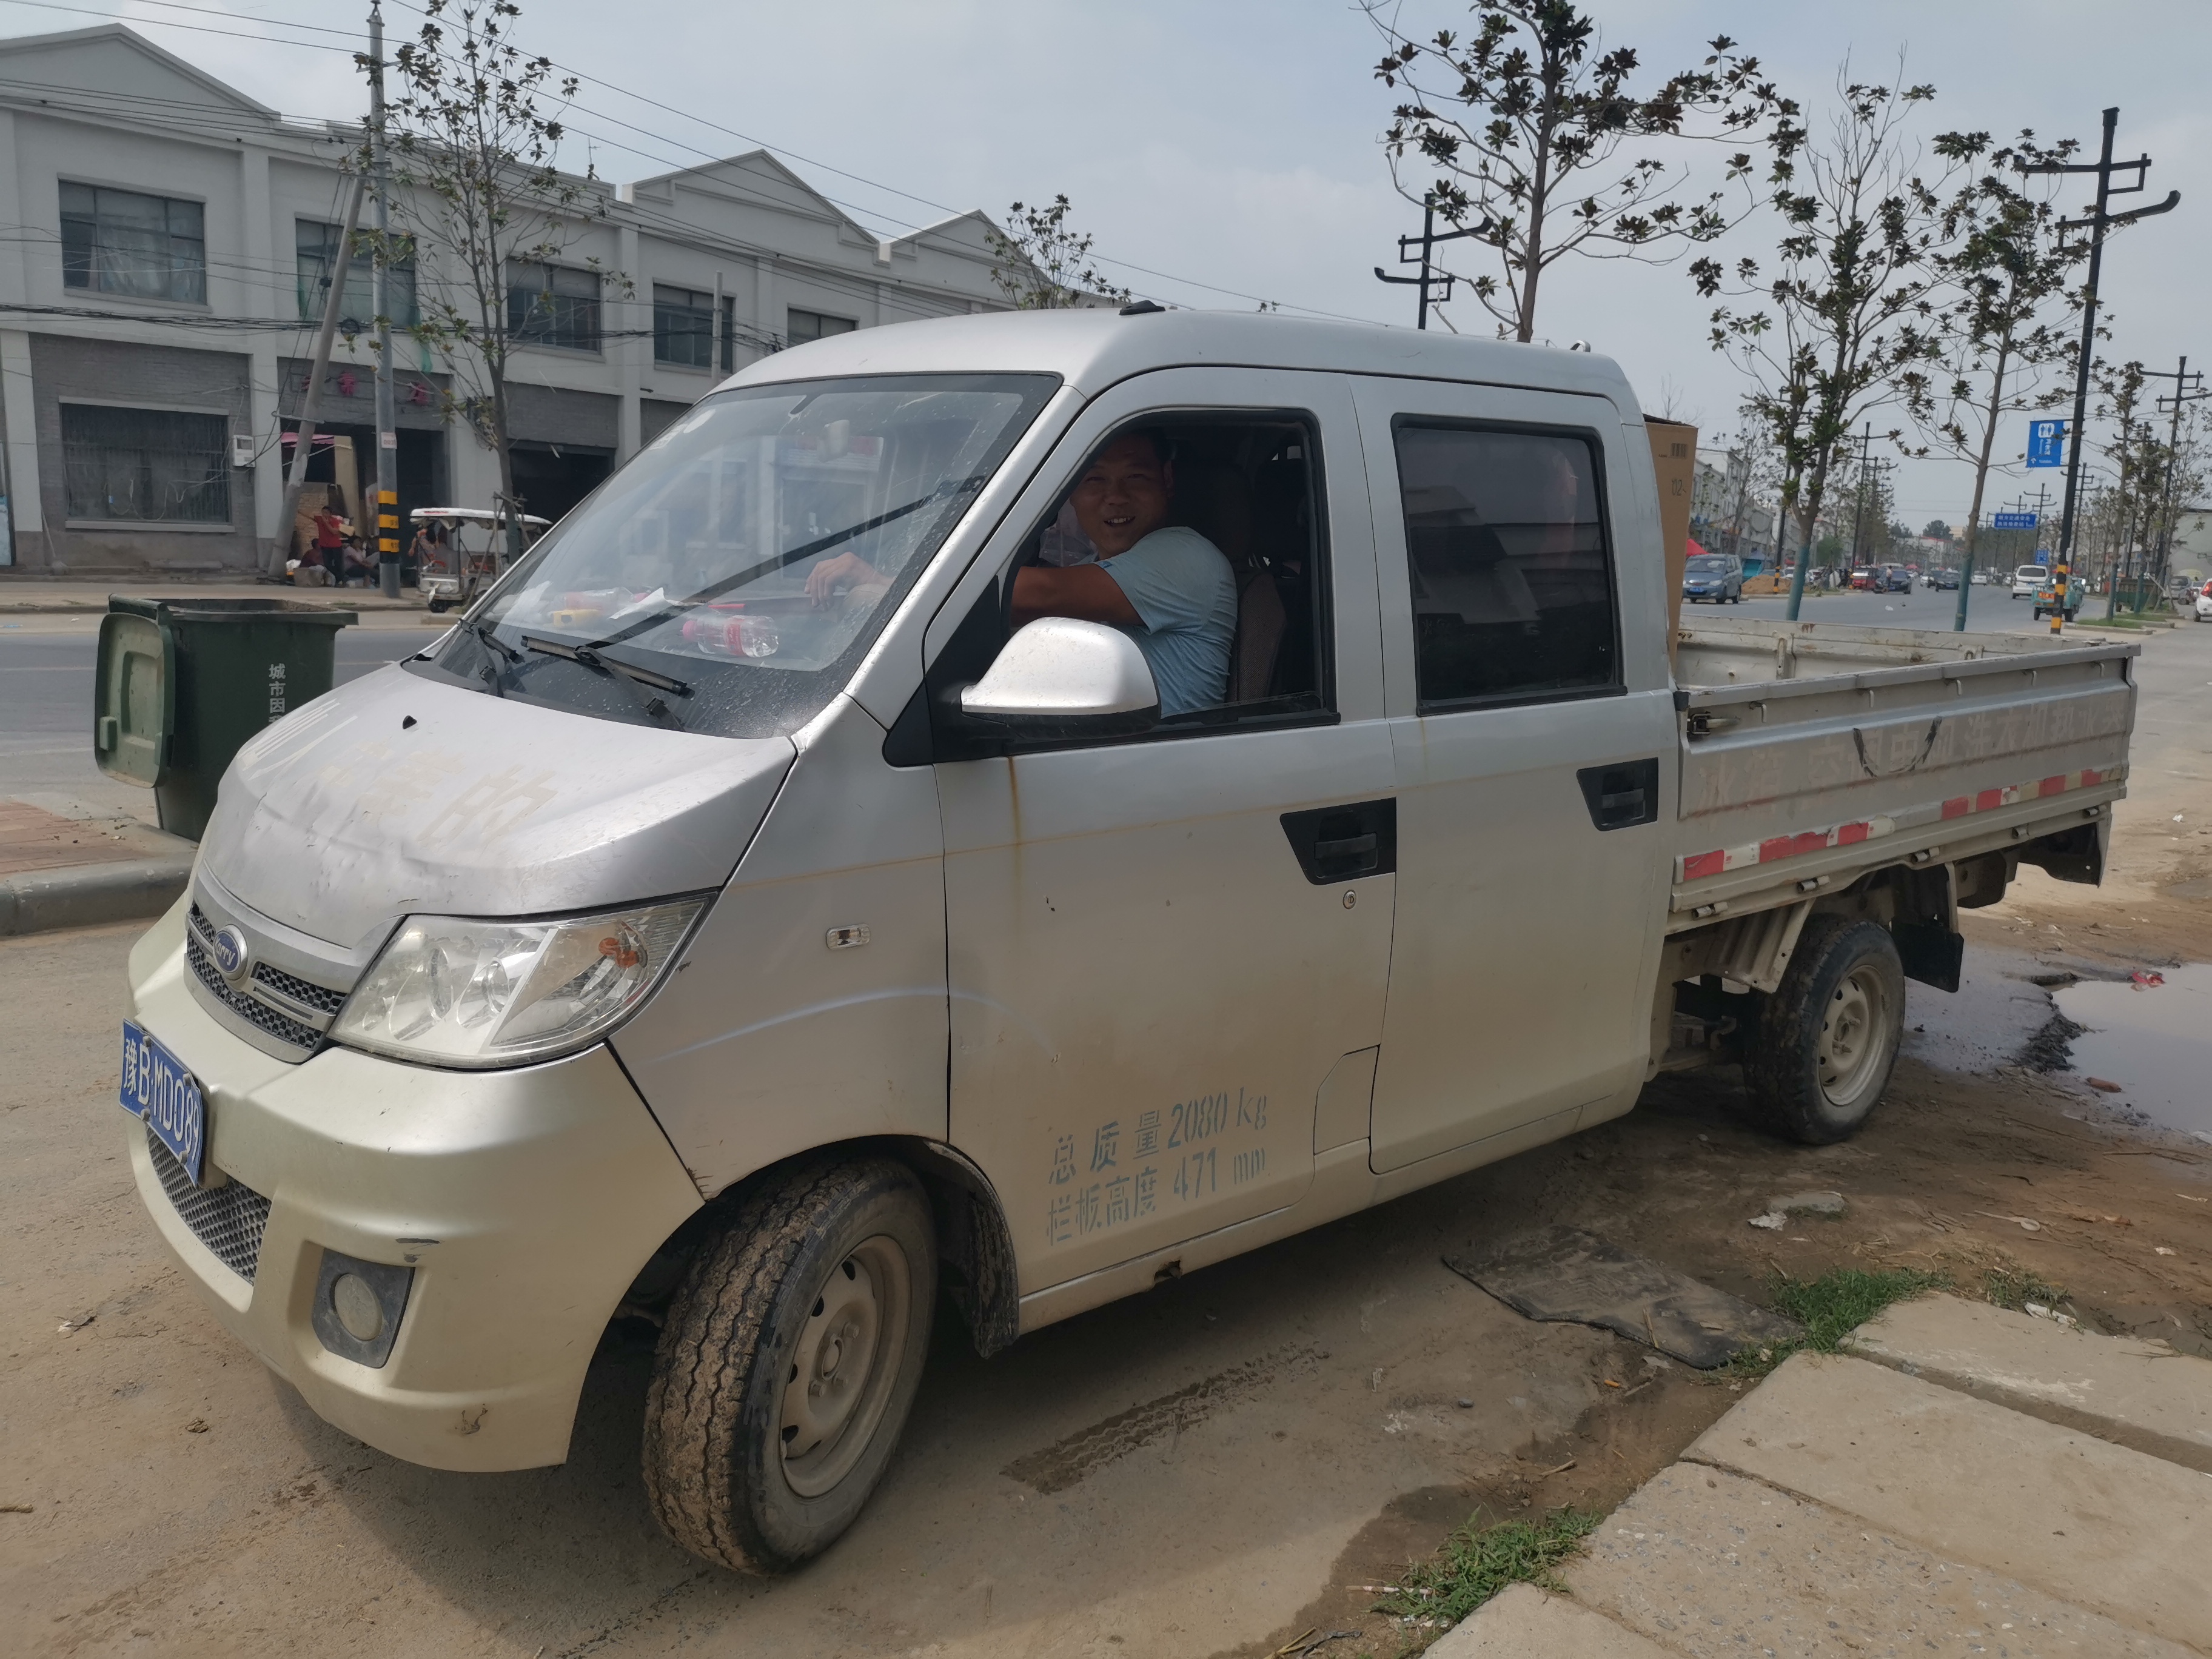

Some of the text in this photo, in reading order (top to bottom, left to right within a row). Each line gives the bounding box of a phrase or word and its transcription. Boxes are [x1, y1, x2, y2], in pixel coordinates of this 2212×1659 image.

[215, 936, 236, 966] Karry
[1048, 1087, 1267, 1184] 总质量 2080 kg
[1047, 1147, 1265, 1246] 栏板高度 471 mm
